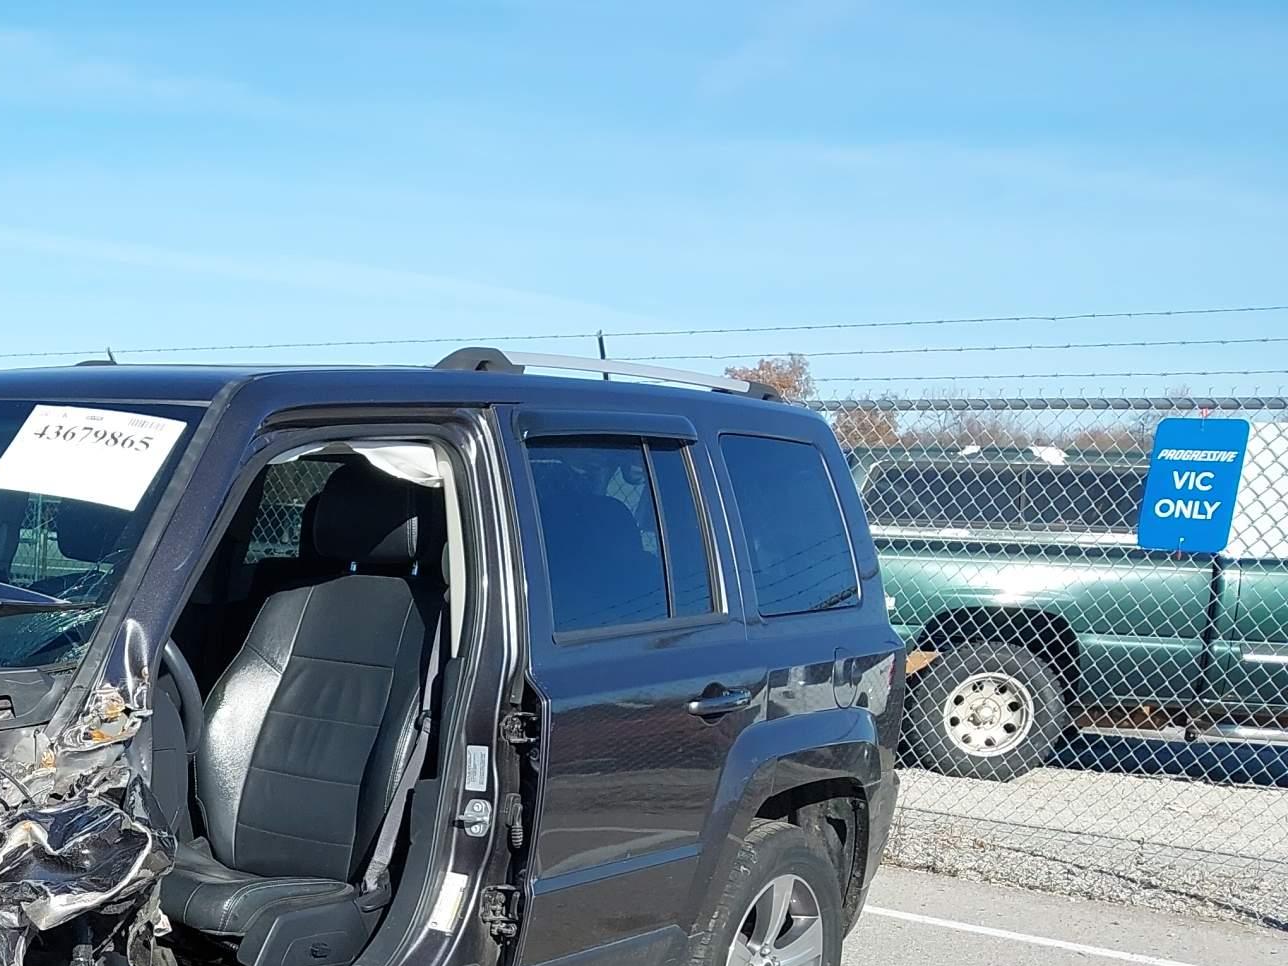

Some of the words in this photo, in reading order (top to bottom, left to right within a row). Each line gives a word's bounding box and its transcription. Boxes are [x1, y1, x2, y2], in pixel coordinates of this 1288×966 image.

[33, 424, 154, 452] 43679865
[1157, 449, 1239, 463] PROGRESSIVE
[1173, 470, 1215, 491] VIC
[1154, 498, 1222, 520] ONLY
